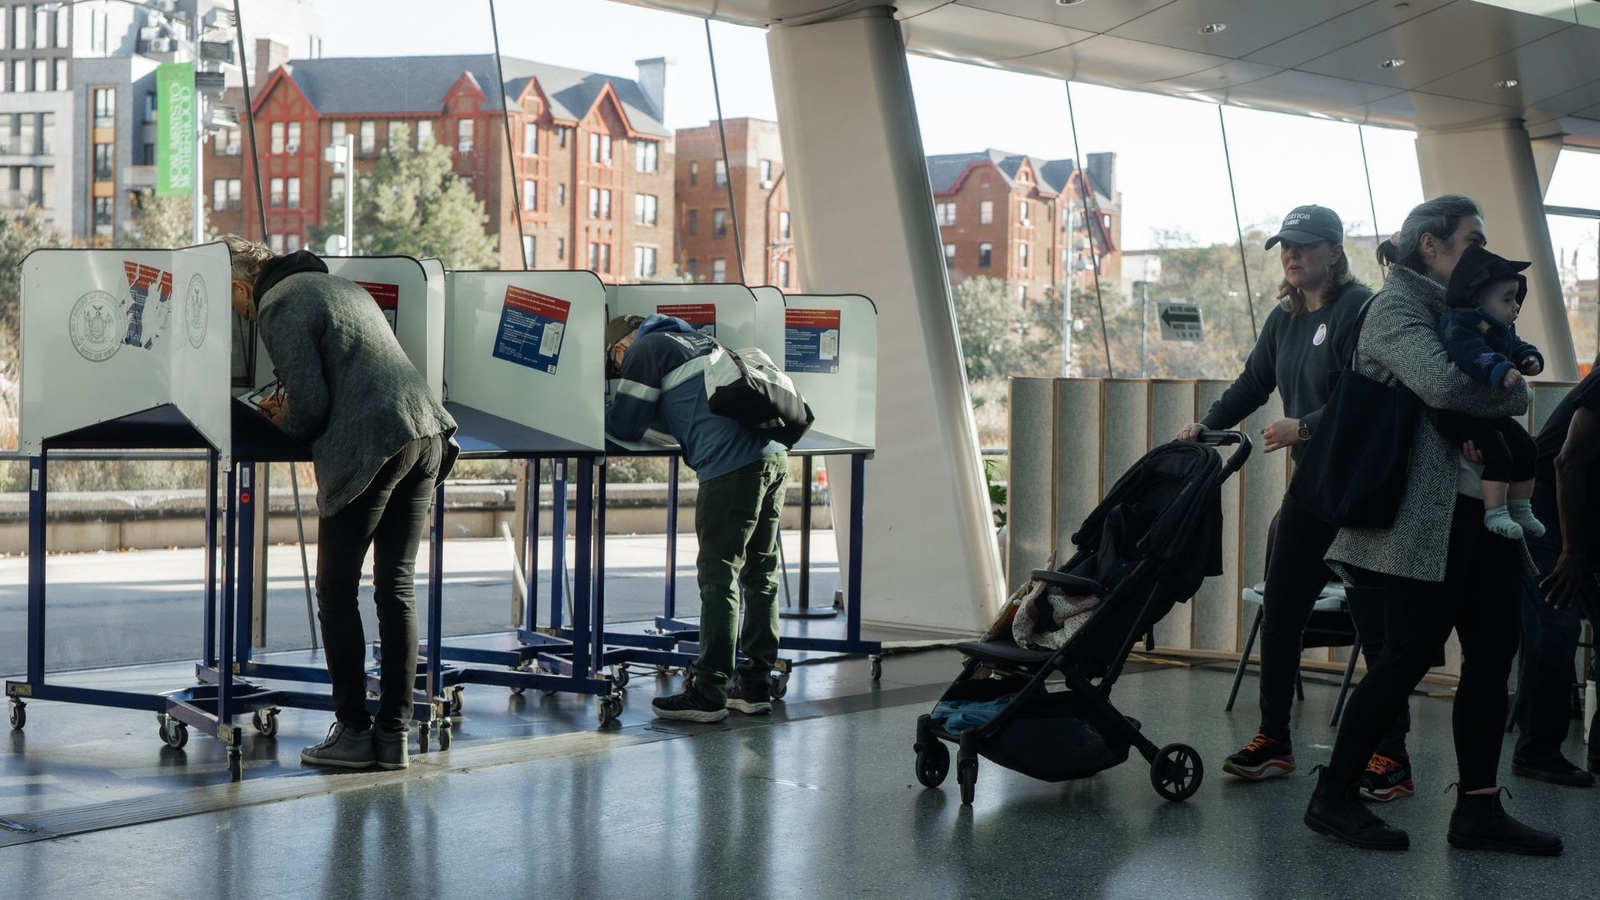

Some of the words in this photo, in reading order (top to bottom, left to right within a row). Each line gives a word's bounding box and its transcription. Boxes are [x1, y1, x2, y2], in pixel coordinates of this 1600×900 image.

[169, 82, 181, 103] TO
[169, 104, 181, 189] MONUMENTS
[180, 86, 191, 188] MOTHERHOOD
